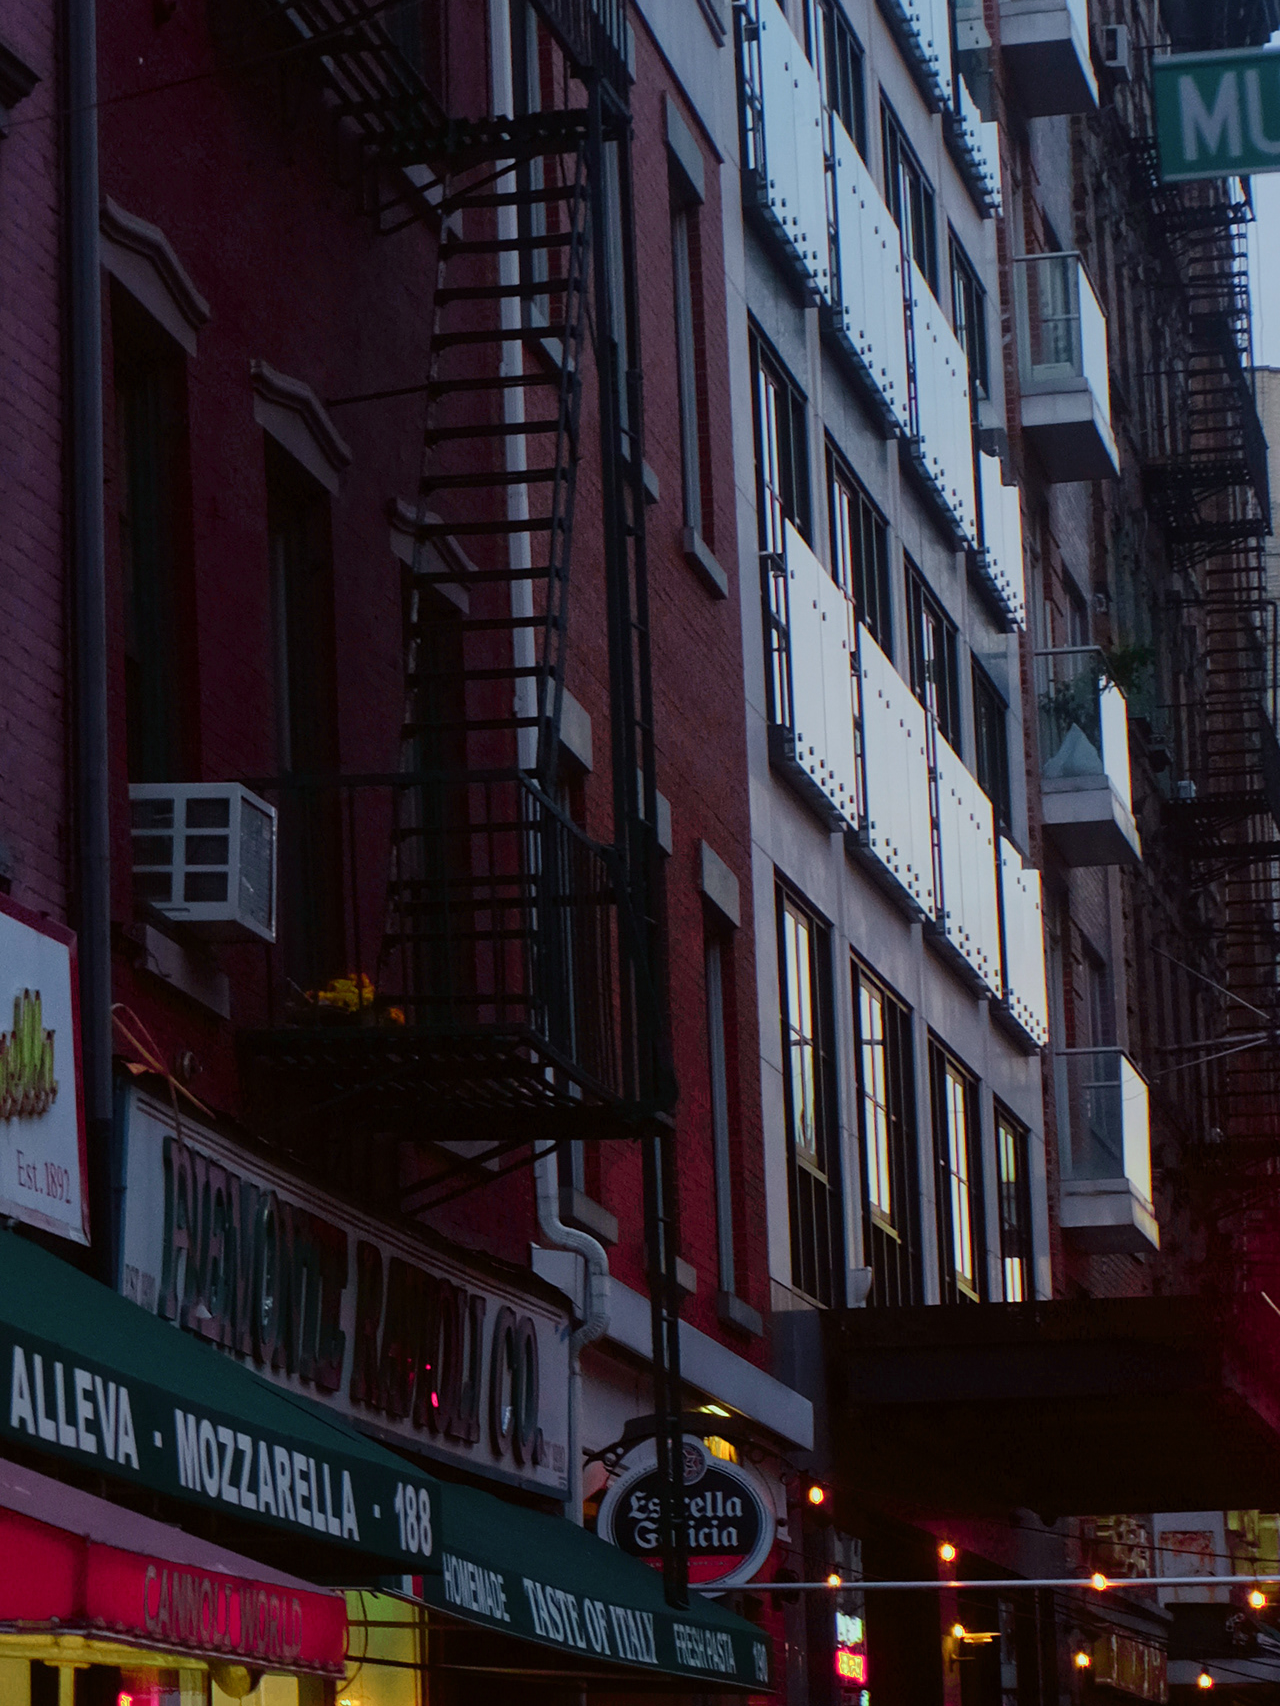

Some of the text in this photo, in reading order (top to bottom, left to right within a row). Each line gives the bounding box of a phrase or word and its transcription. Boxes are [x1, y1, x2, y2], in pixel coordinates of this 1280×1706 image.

[16, 1149, 72, 1204] Est. 1892
[10, 1344, 140, 1470] ALLEVA
[173, 1407, 362, 1543] MOZZARELLA
[393, 1480, 433, 1558] 188
[628, 1491, 743, 1520] Esella
[634, 1520, 739, 1549] Gicia
[144, 1563, 303, 1659] CANNOLI WORLD
[442, 1550, 512, 1624] HOMEMADE
[521, 1575, 659, 1665] TASTE OF ITALY
[673, 1622, 737, 1675] FRESH PASTA
